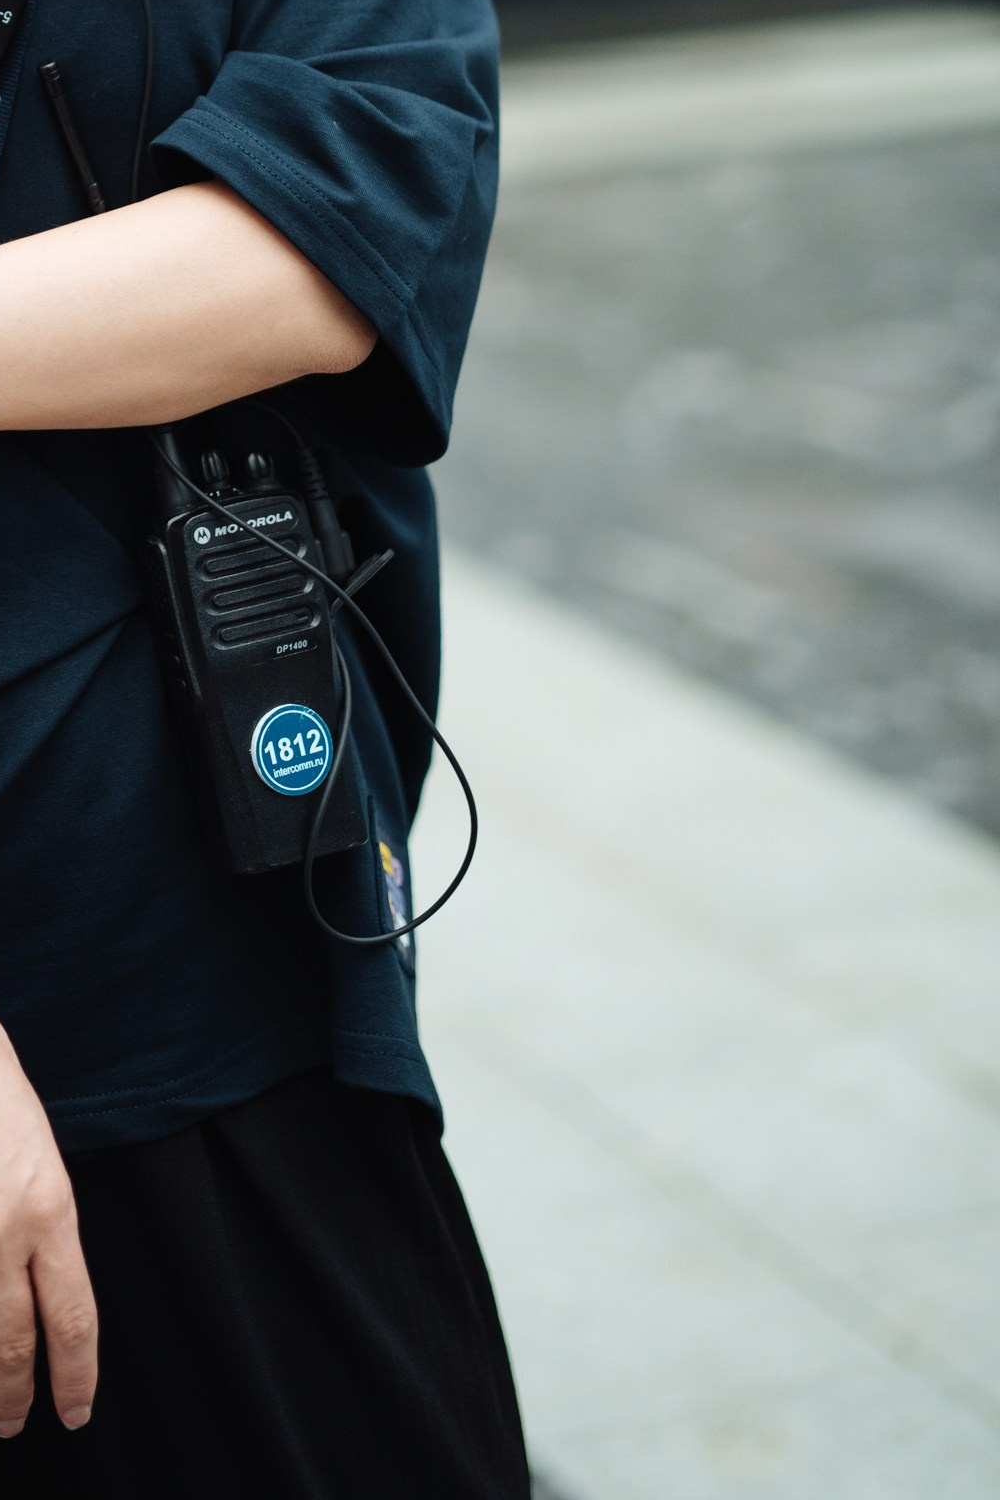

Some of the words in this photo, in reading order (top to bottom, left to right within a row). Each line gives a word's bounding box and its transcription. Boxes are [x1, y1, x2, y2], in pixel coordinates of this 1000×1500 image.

[214, 510, 293, 537] MOOROLA
[276, 639, 308, 655] DP1400
[264, 729, 324, 765] 1812
[273, 757, 324, 779] intercomm.ru
